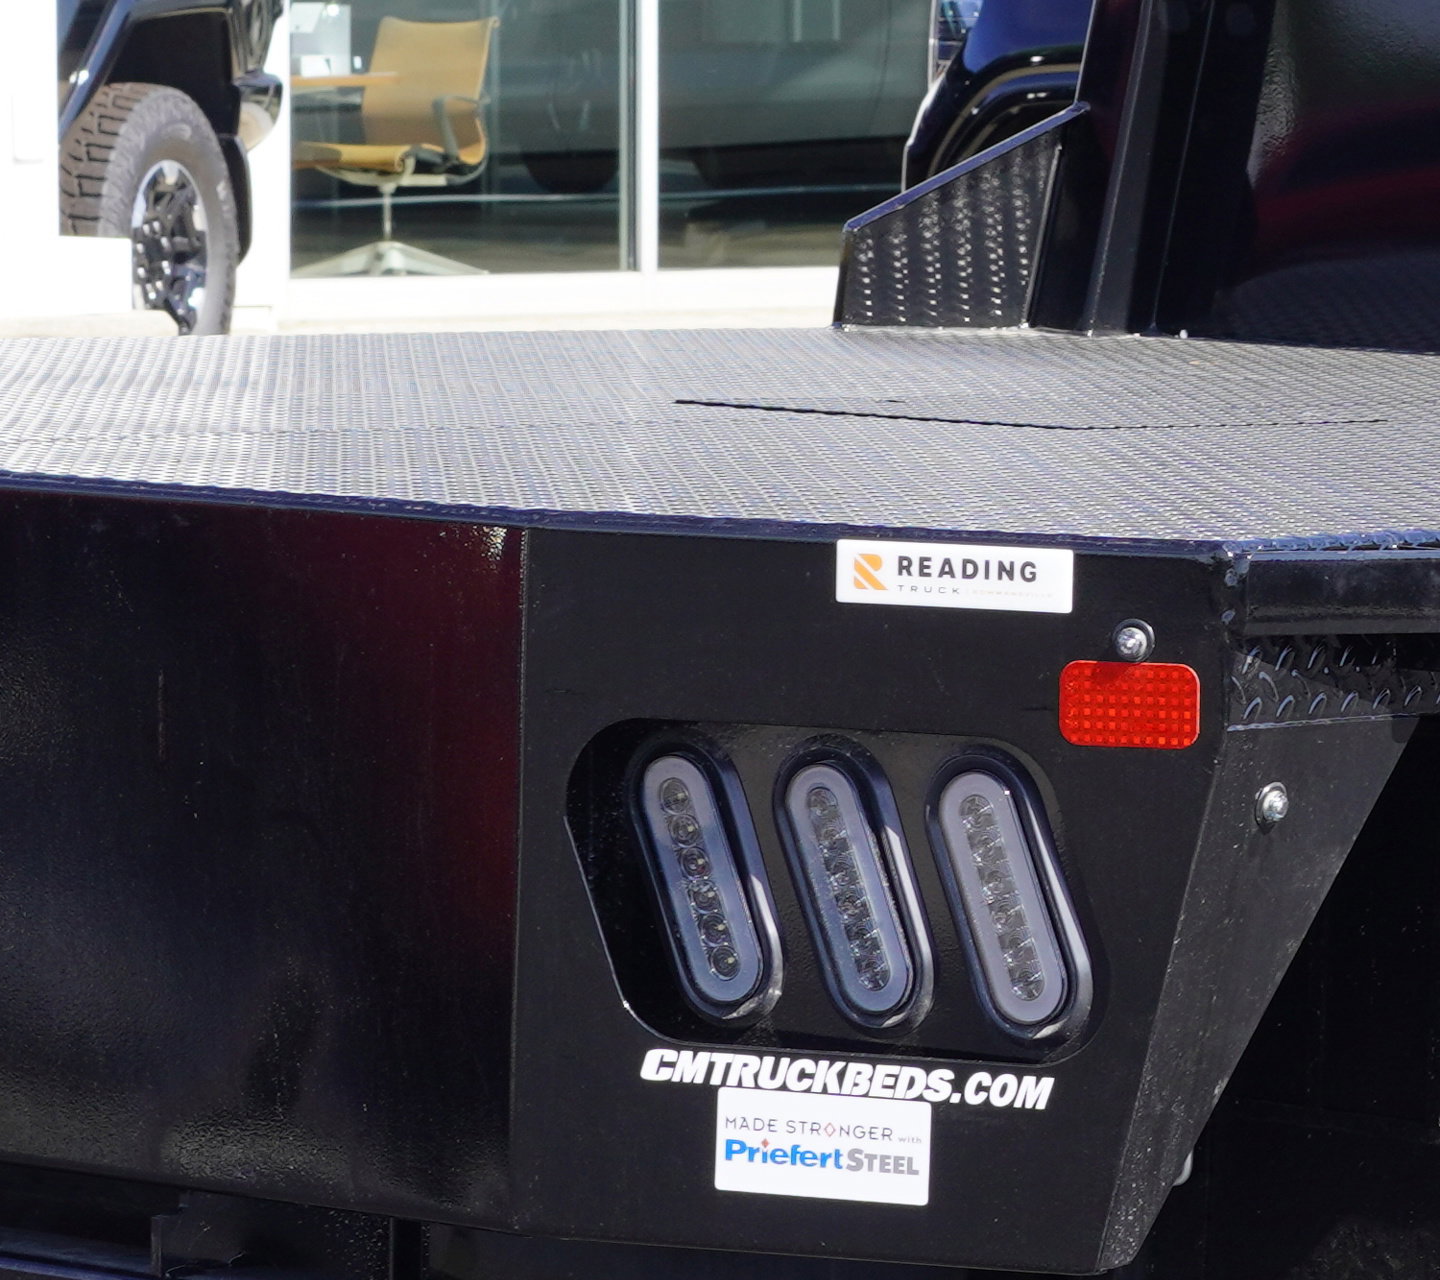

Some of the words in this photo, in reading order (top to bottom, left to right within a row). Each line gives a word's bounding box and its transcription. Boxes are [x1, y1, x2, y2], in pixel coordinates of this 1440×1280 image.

[897, 555, 1038, 583] READING
[897, 584, 960, 595] TRUCK
[640, 1048, 1055, 1110] CMTRUCKBEDS.COM
[725, 1116, 777, 1133] MADE
[898, 1134, 922, 1145] with
